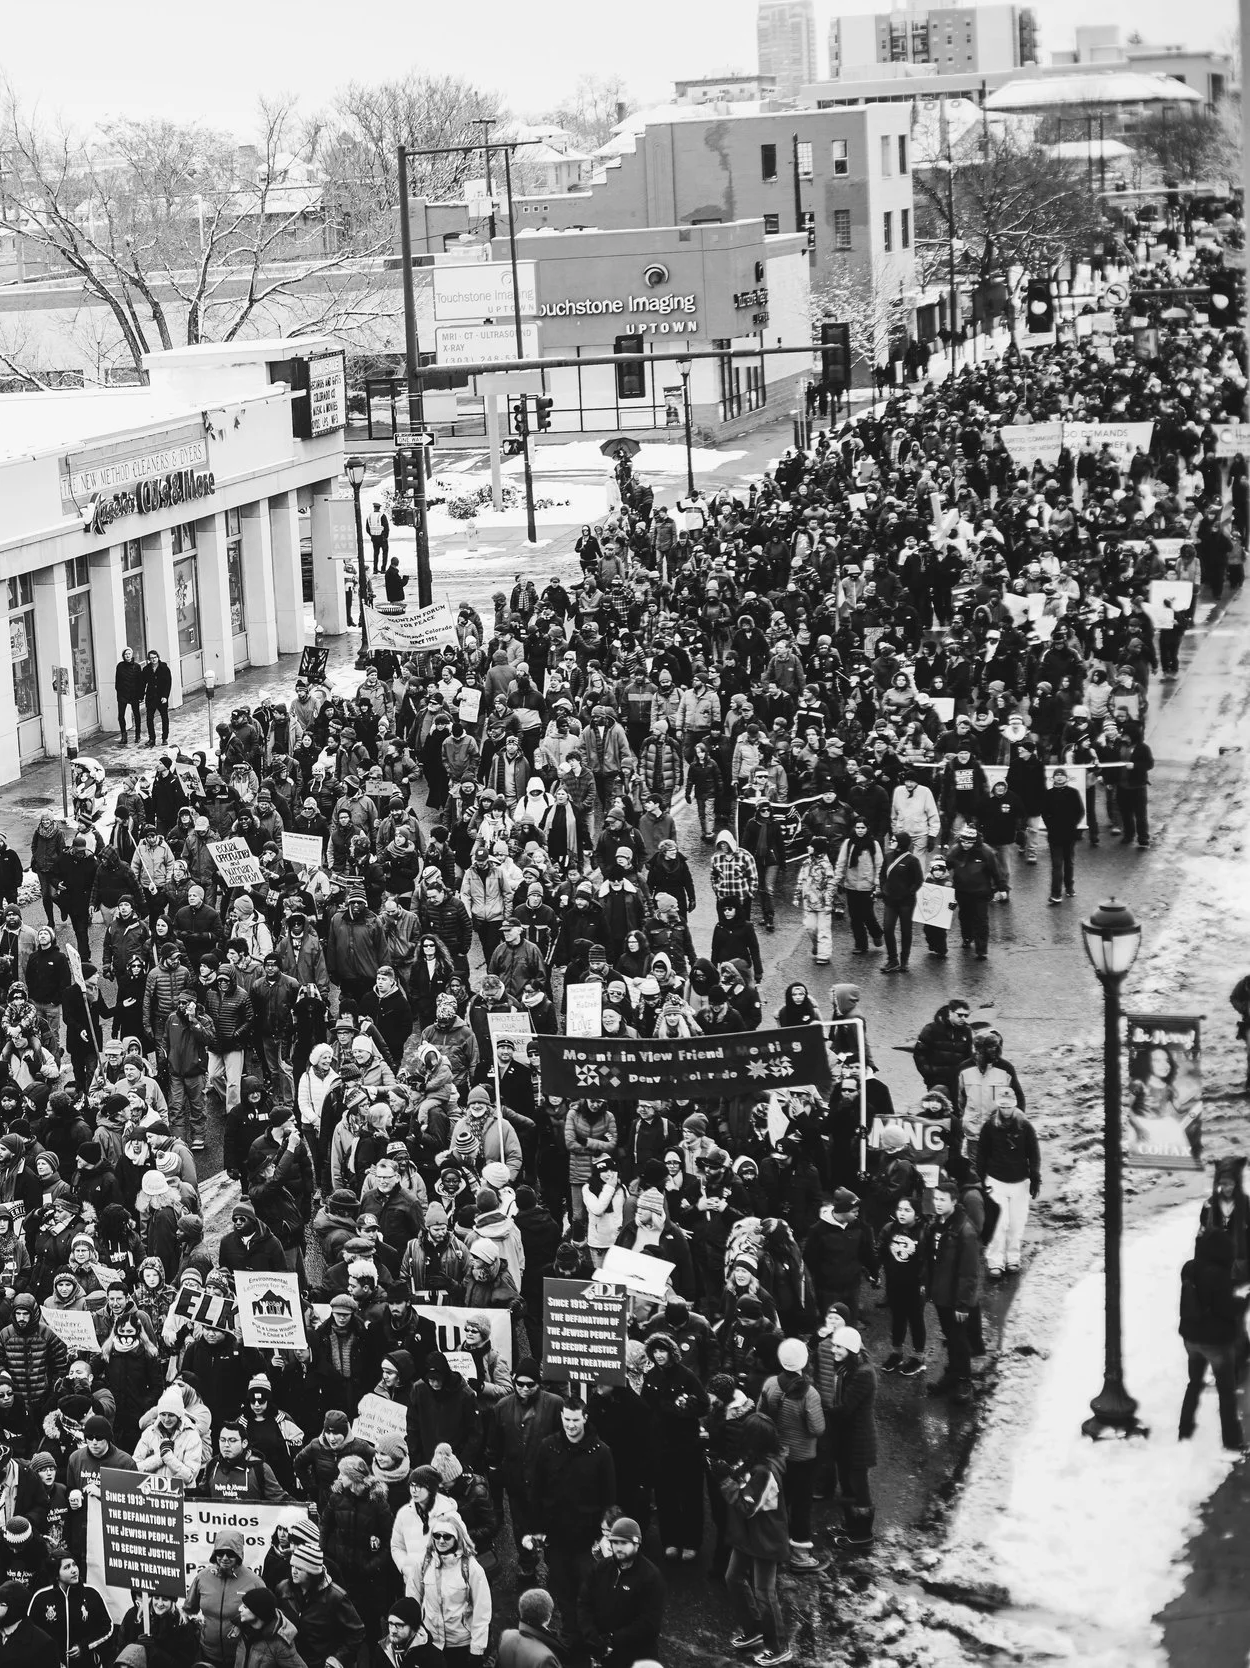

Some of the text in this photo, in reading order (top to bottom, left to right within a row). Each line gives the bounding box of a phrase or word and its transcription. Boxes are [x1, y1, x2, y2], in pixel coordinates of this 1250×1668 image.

[436, 289, 534, 304] Touchstone Imaing
[539, 294, 696, 317] ouchstone Imaging
[464, 332, 473, 340] CT
[480, 330, 532, 339] ULTRASOND
[626, 321, 698, 335] UPTOWN
[443, 344, 465, 352] X-RAY
[80, 472, 97, 490] NEW
[100, 464, 129, 487] METHOD
[132, 453, 169, 478] CLEANERS
[180, 444, 202, 465] DYERS
[422, 604, 446, 617] FORUM
[414, 614, 436, 627] PEACE
[424, 625, 452, 635] Colorado
[222, 865, 253, 876] human
[572, 1019, 593, 1031] LOVE
[639, 1051, 672, 1062] View
[243, 1284, 270, 1292] Learning
[280, 1285, 296, 1294] Kids
[580, 1284, 624, 1300] ADL
[174, 1286, 239, 1330] ELK
[548, 1296, 569, 1308] SINCE
[604, 1302, 622, 1312] STOP
[550, 1312, 619, 1326] THE DEFAMATION OF
[547, 1326, 560, 1336] THE
[561, 1326, 589, 1338] JEWISH
[551, 1341, 618, 1354] TO SECURE JUSTICE
[547, 1355, 621, 1369] AND FAIR TREATMENT
[569, 1370, 579, 1380] TO
[136, 1475, 180, 1494] ADL
[105, 1490, 126, 1502] SINCE
[127, 1494, 146, 1506] 1913:
[161, 1498, 179, 1510] STOP
[108, 1509, 122, 1519] THE
[122, 1510, 166, 1526] DEFAMATION
[167, 1517, 176, 1527] OF
[199, 1511, 259, 1527] Unidos
[106, 1524, 119, 1536] THE
[120, 1525, 147, 1539] JEWISH
[111, 1541, 176, 1560] TO SECURE JUSTICE
[109, 1557, 122, 1568] AND
[123, 1559, 139, 1570] FAIR
[140, 1563, 181, 1578] TREATMENT
[130, 1577, 139, 1587] TO
